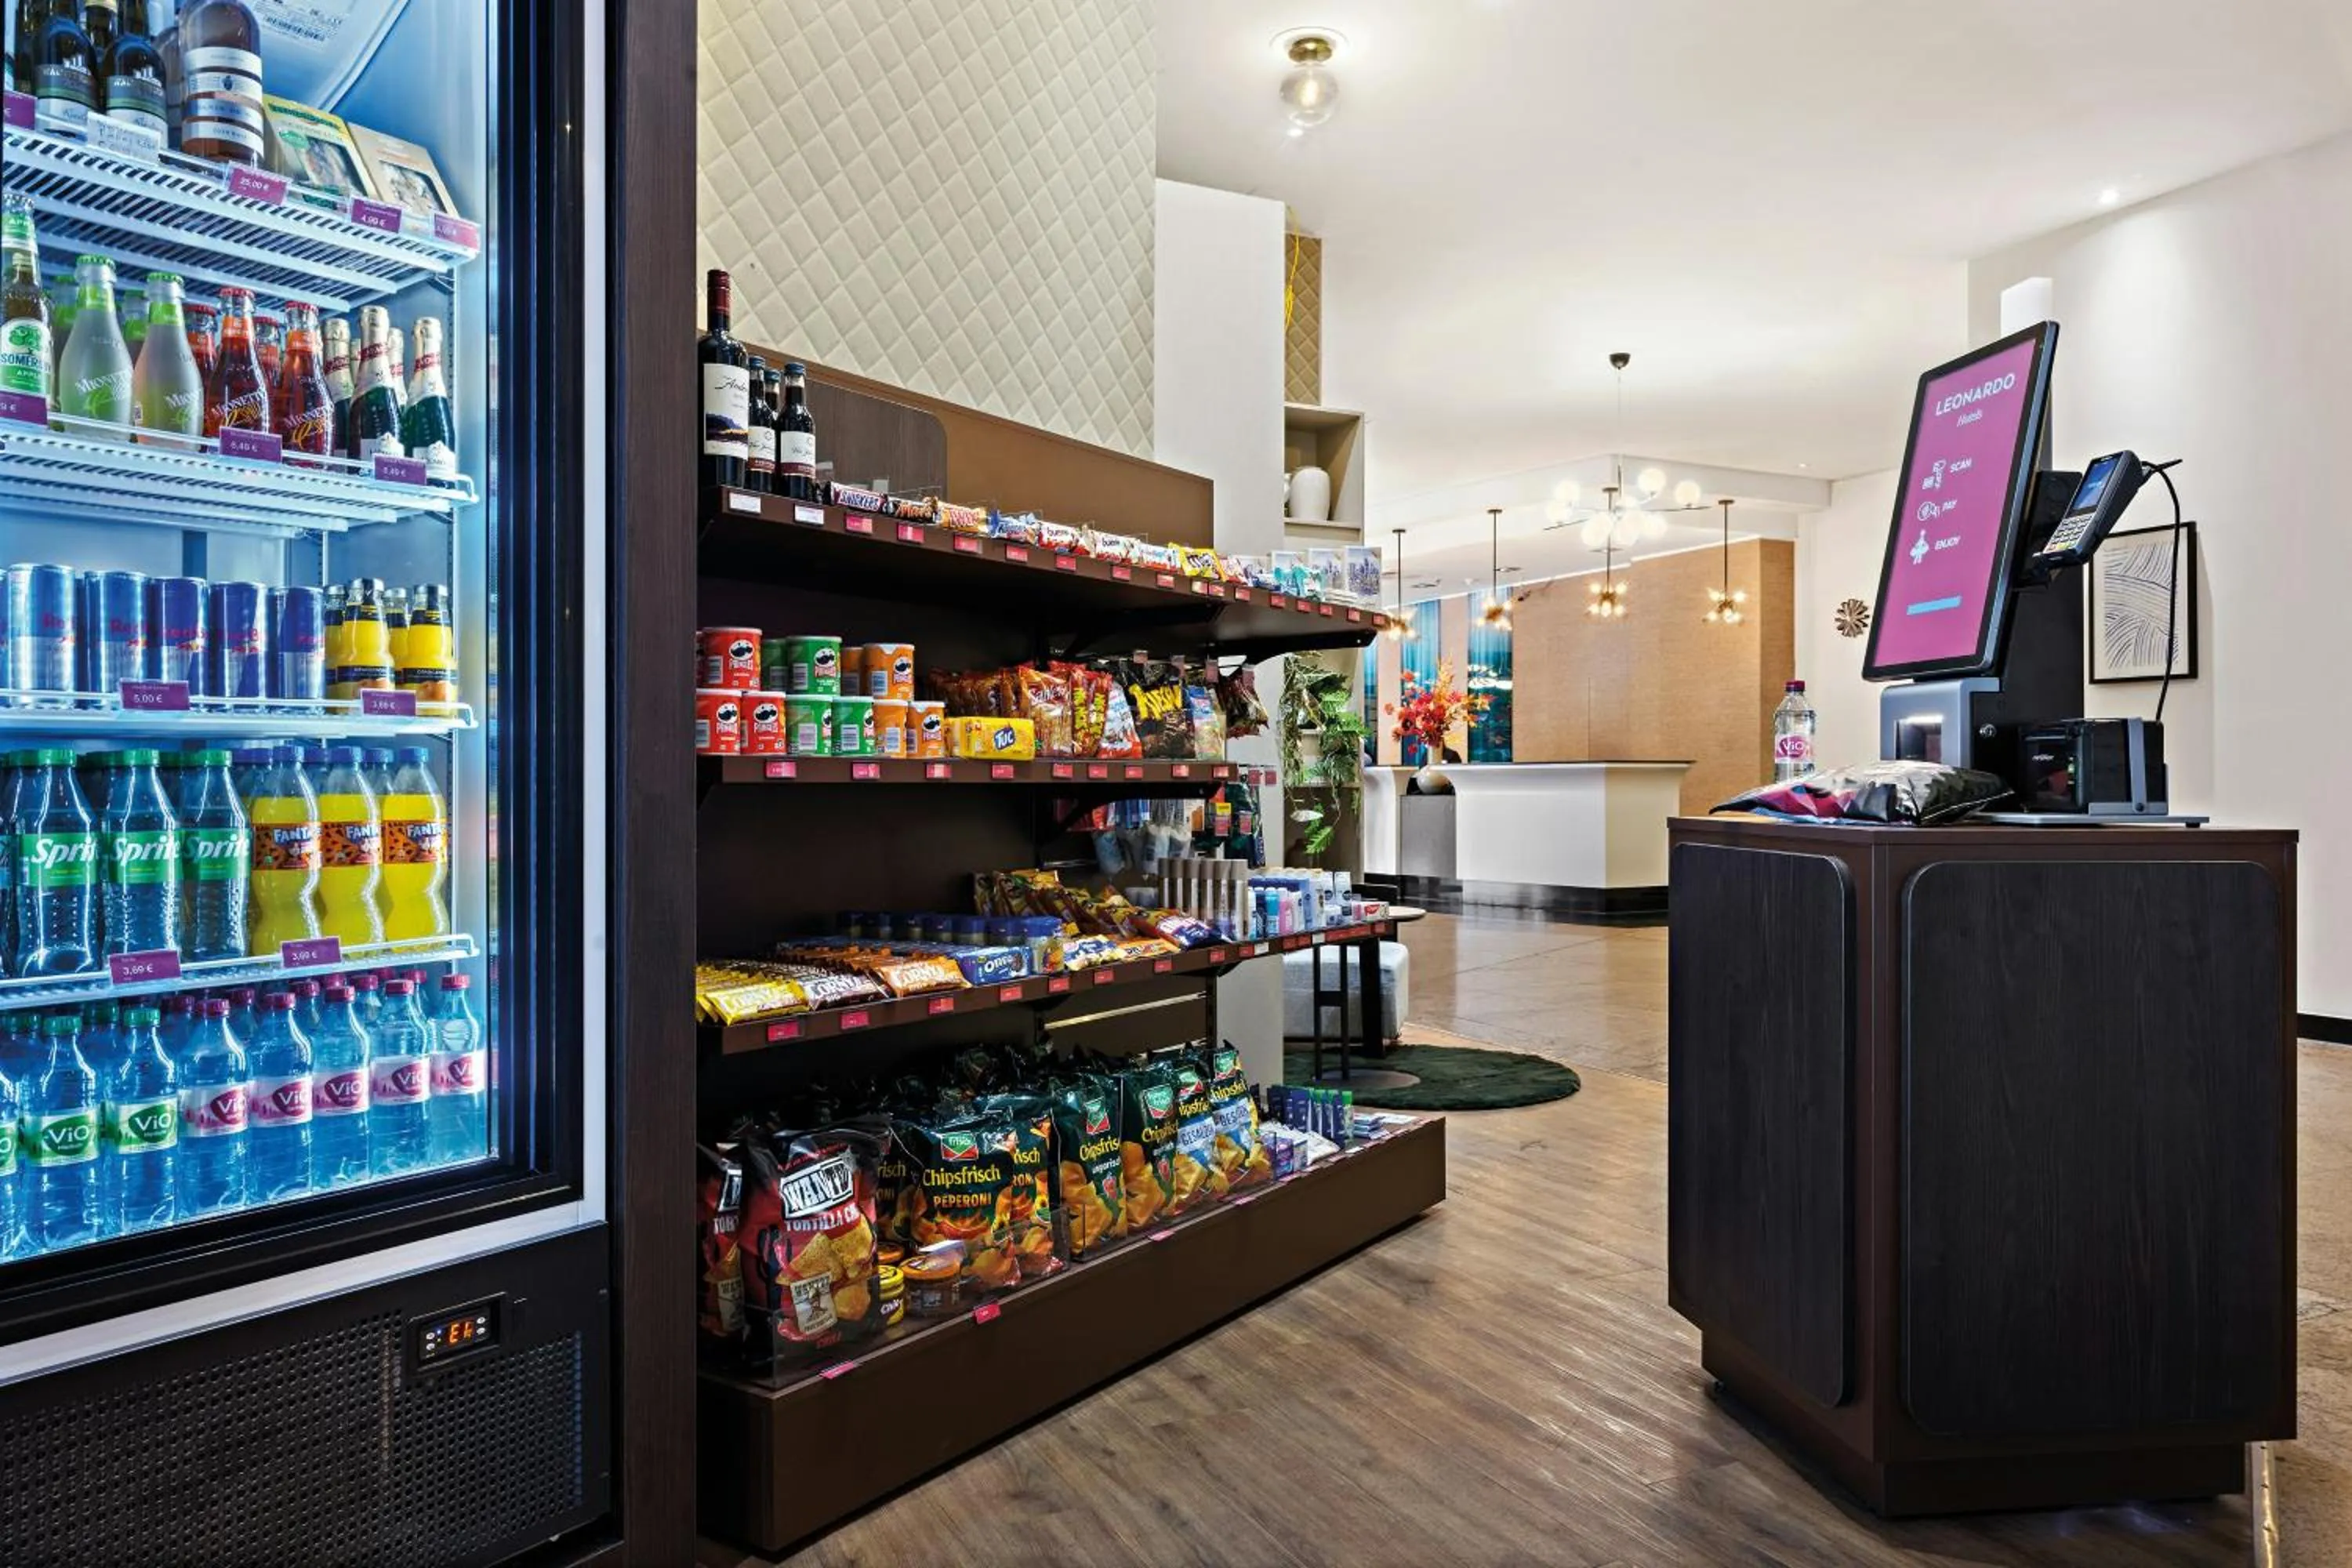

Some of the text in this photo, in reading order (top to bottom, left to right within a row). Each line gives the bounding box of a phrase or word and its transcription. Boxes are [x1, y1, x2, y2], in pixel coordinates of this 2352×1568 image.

[1935, 372, 2016, 416] LEONARDO
[1950, 457, 1973, 474] SCAN
[1934, 535, 1961, 550] ENJOY
[996, 729, 1014, 748] TUC
[923, 1164, 1001, 1188] Chipsfrisch
[934, 1192, 992, 1209] PEPERONI
